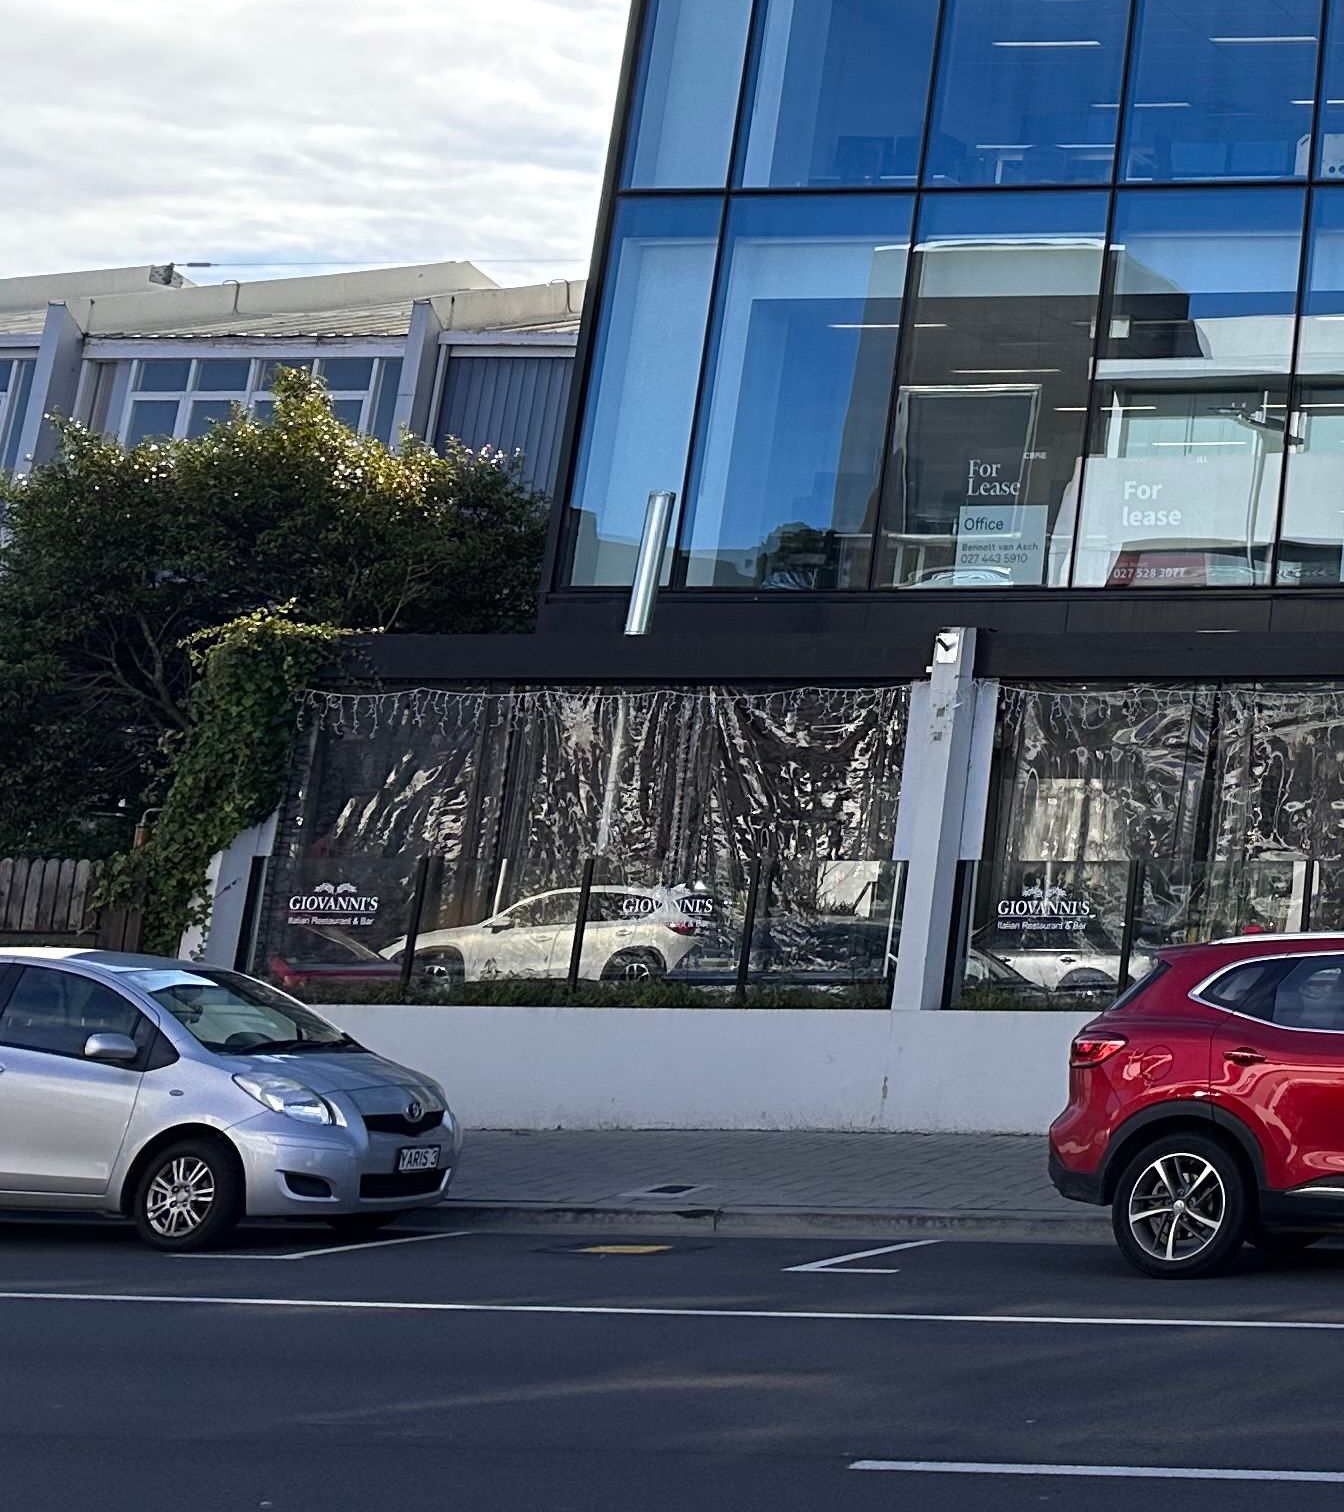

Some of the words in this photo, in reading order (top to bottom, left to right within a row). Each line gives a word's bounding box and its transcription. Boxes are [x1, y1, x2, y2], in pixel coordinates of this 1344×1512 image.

[968, 459, 1002, 477] For
[967, 478, 1020, 496] Lease
[1123, 480, 1162, 500] For
[1122, 506, 1182, 526] lease
[964, 517, 1004, 531] Office
[1016, 542, 1039, 551] Asch
[960, 553, 980, 563] 027
[982, 553, 1001, 563] 443
[1004, 553, 1028, 563] 5910
[1113, 568, 1135, 579] 027
[289, 895, 379, 911] GIOVANNI'S
[998, 900, 1090, 915] GIOVANNI'S
[353, 916, 359, 926] &
[360, 916, 375, 926] Bar
[402, 1150, 428, 1167] YARIS
